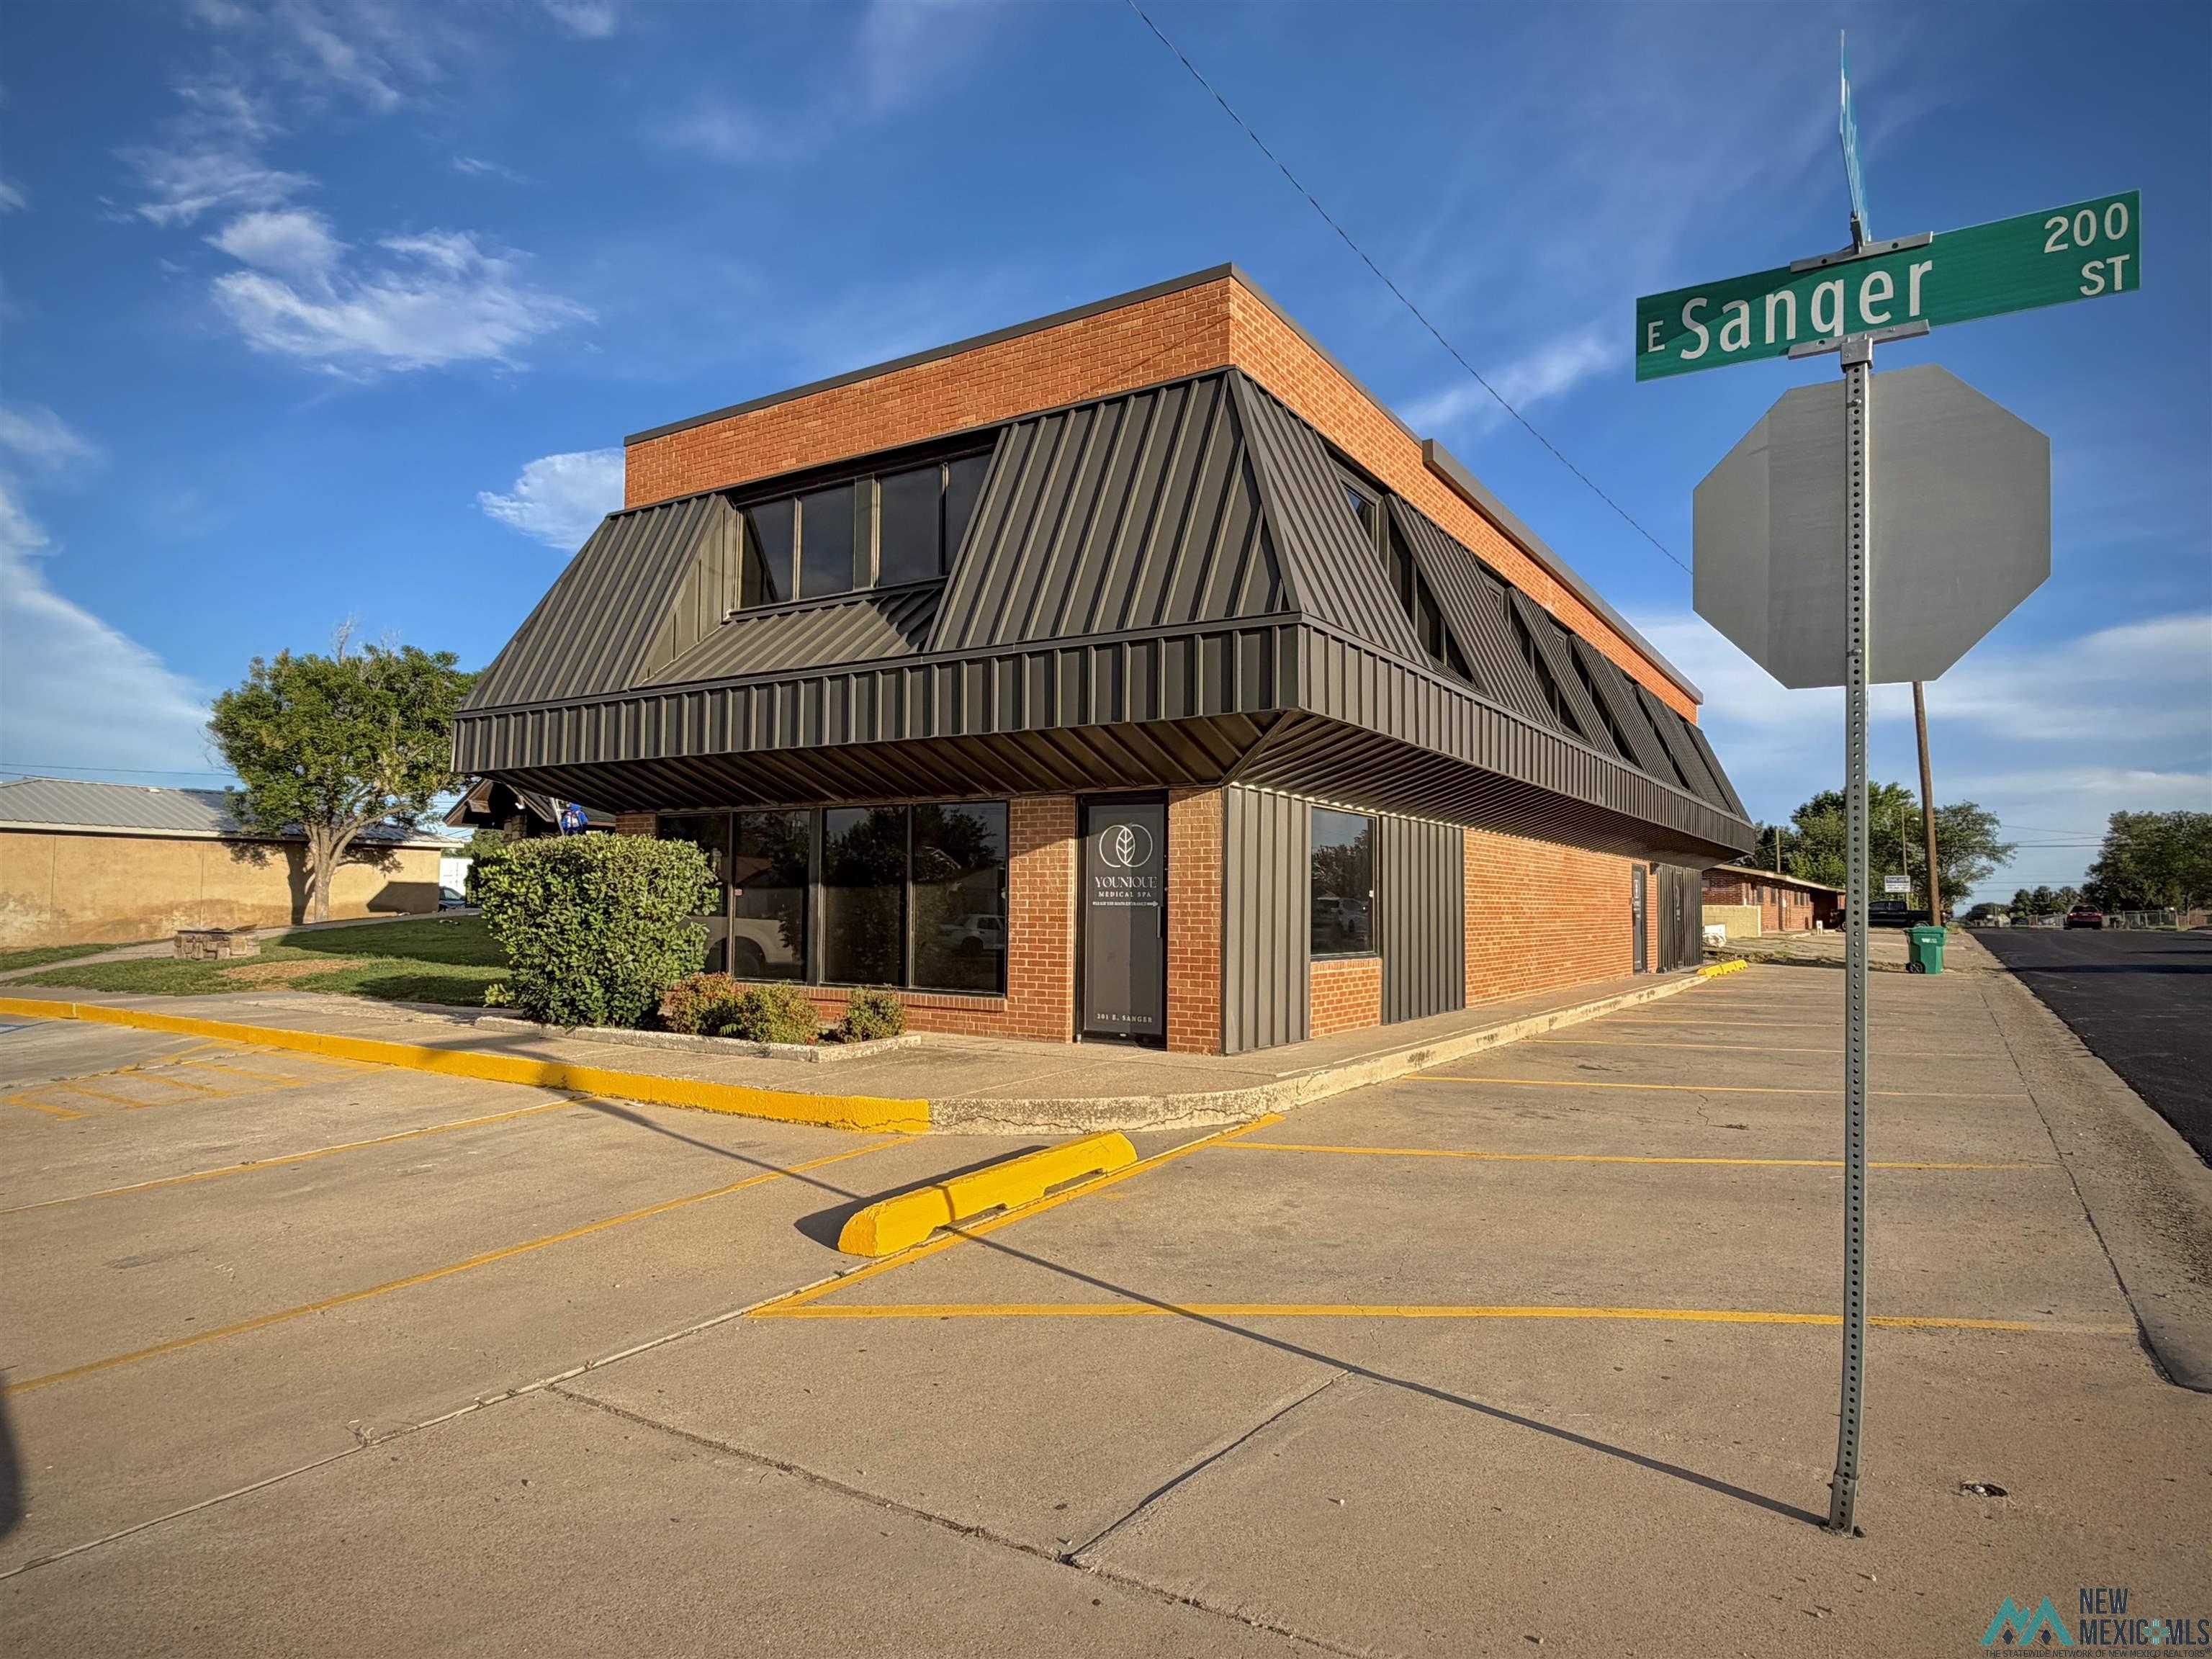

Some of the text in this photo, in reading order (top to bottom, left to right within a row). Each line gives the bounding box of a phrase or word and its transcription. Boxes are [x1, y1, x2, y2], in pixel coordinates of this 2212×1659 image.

[2044, 202, 2130, 254] 200
[2080, 253, 2130, 297] ST
[1647, 260, 1933, 361] E Sanger
[1122, 1015, 1153, 1023] SANGER
